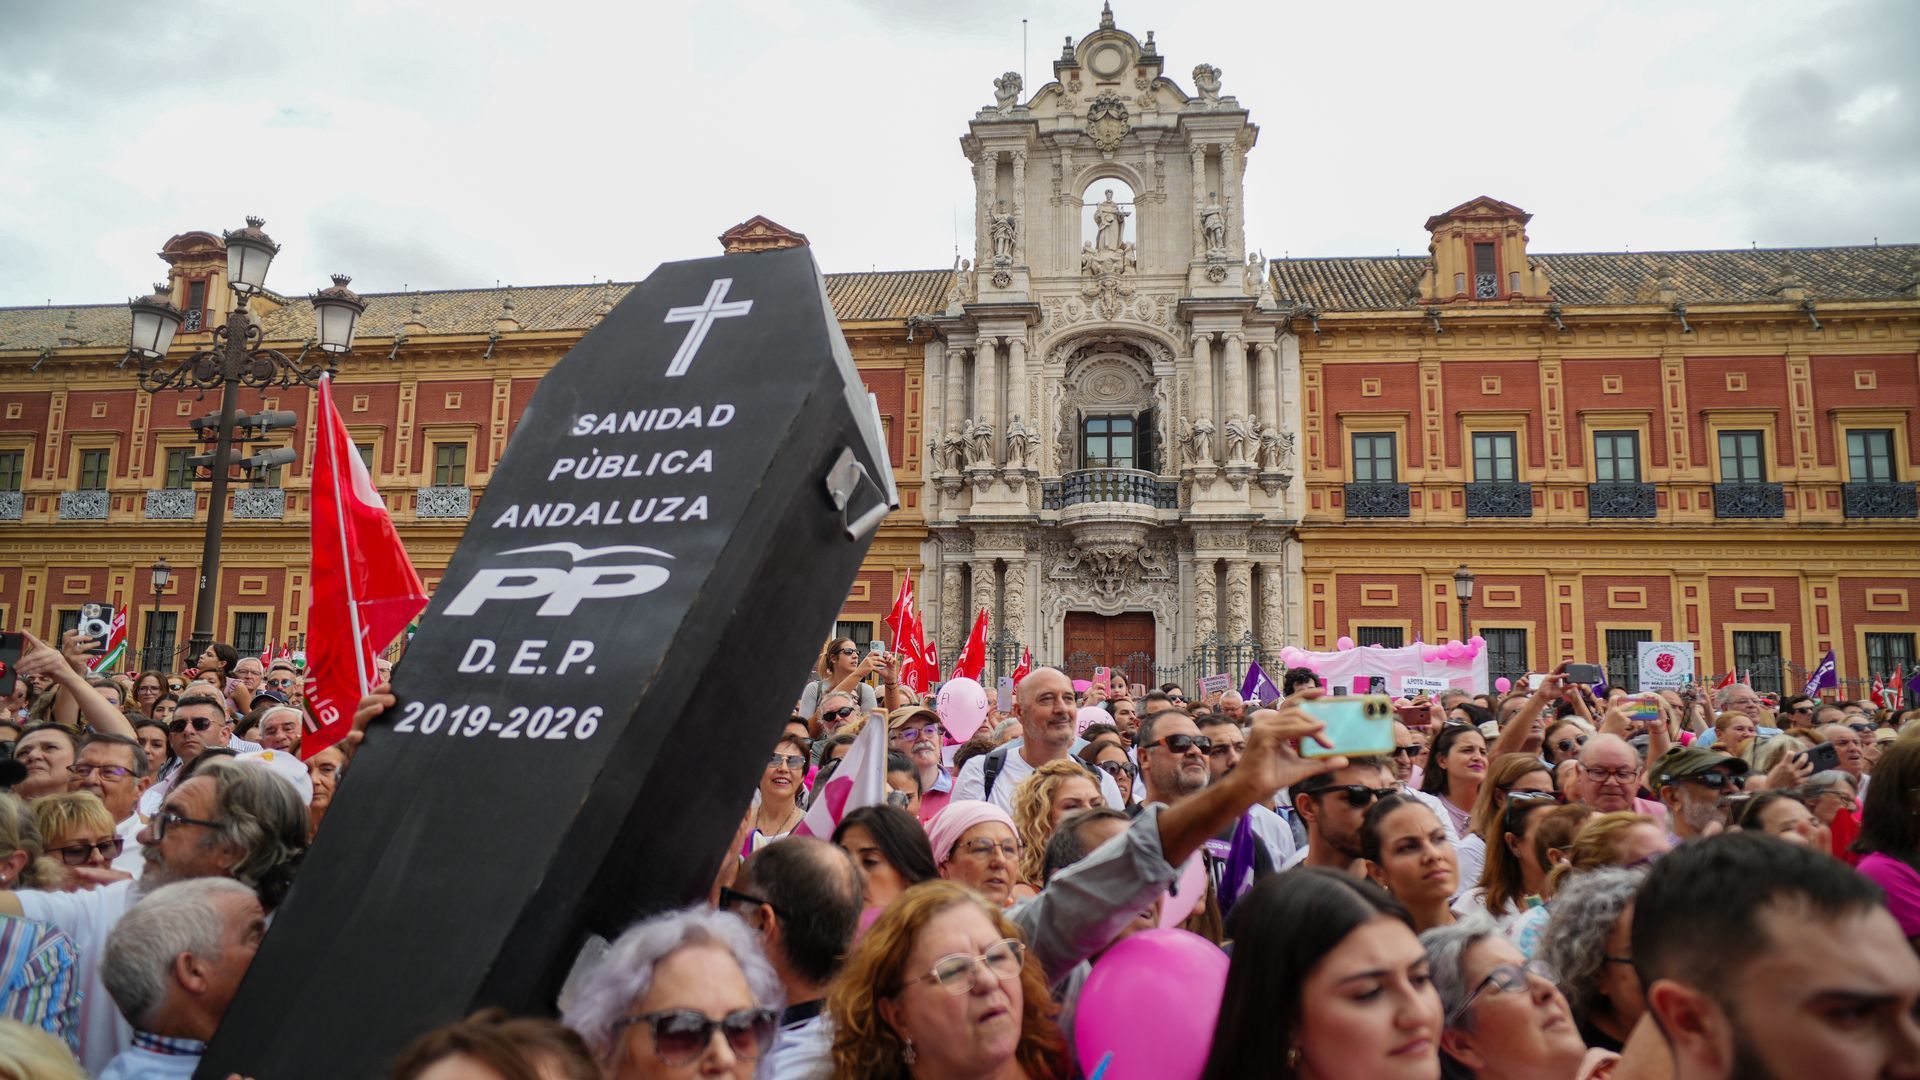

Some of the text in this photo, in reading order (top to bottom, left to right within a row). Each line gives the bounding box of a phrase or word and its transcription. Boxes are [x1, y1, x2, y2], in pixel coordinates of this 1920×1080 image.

[571, 403, 736, 436] SANIDAD
[491, 495, 708, 529] ANDALUZA
[442, 564, 671, 617] PP
[393, 701, 604, 740] 2019-2026
